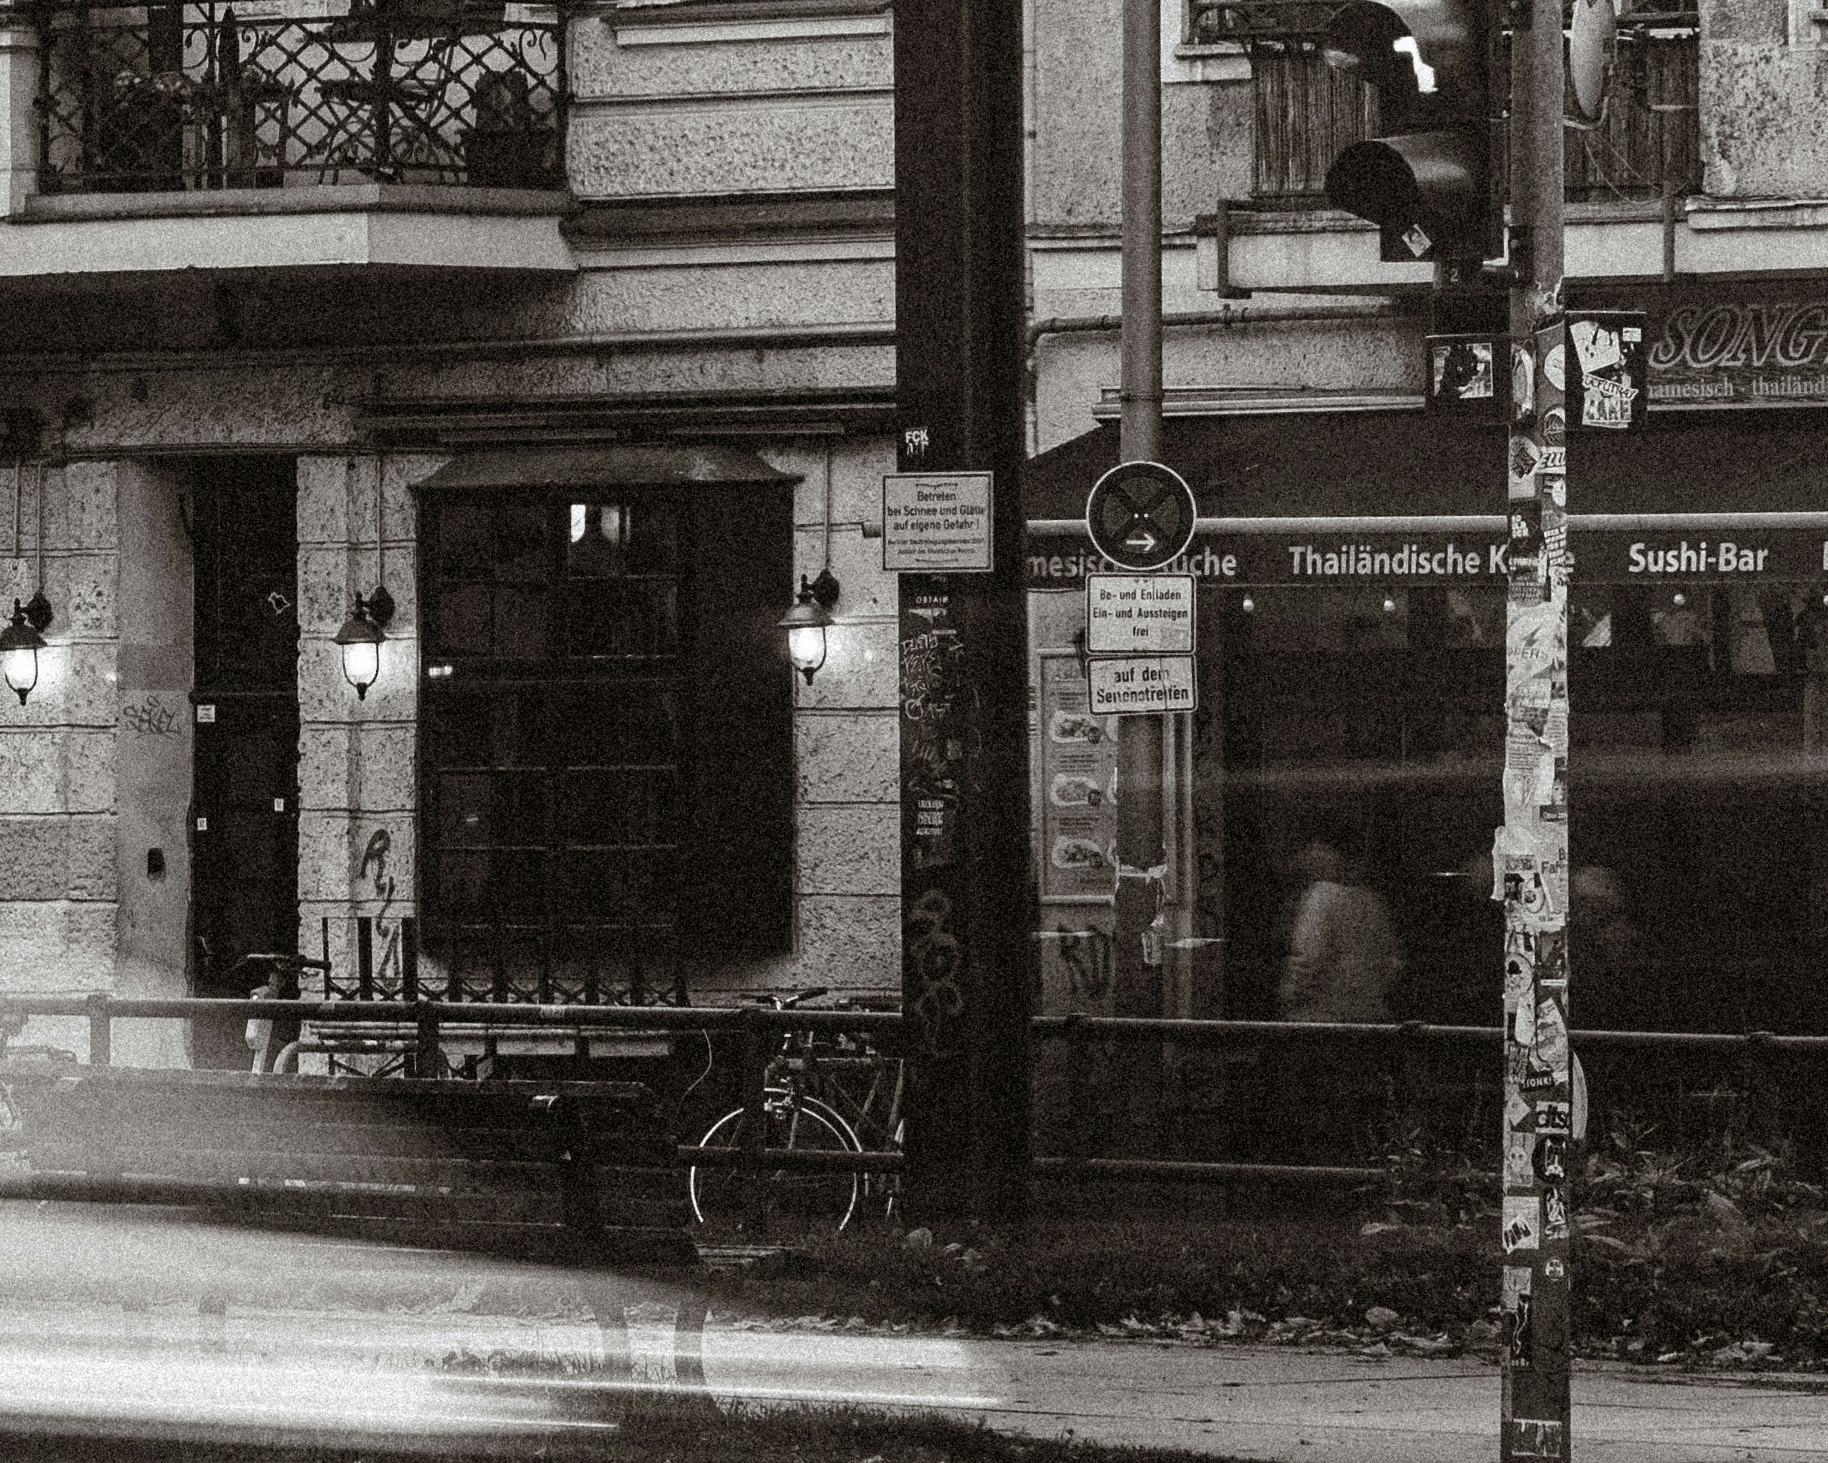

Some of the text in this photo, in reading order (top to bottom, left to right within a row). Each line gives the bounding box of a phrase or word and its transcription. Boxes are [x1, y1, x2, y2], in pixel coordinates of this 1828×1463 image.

[917, 490, 956, 502] Betreten
[887, 506, 901, 516] bei
[903, 505, 937, 516] Schnee
[940, 504, 957, 515] und
[893, 519, 908, 530] auf
[911, 519, 941, 533] eigene
[1289, 544, 1480, 574] Thailändische
[1629, 542, 1768, 573] Sushi-Bar
[1120, 590, 1136, 600] und
[1141, 589, 1181, 600] Entladen
[1093, 607, 1188, 621] Ein- und Aussteigen
[1132, 625, 1149, 637] frei
[1113, 668, 1135, 683] auf
